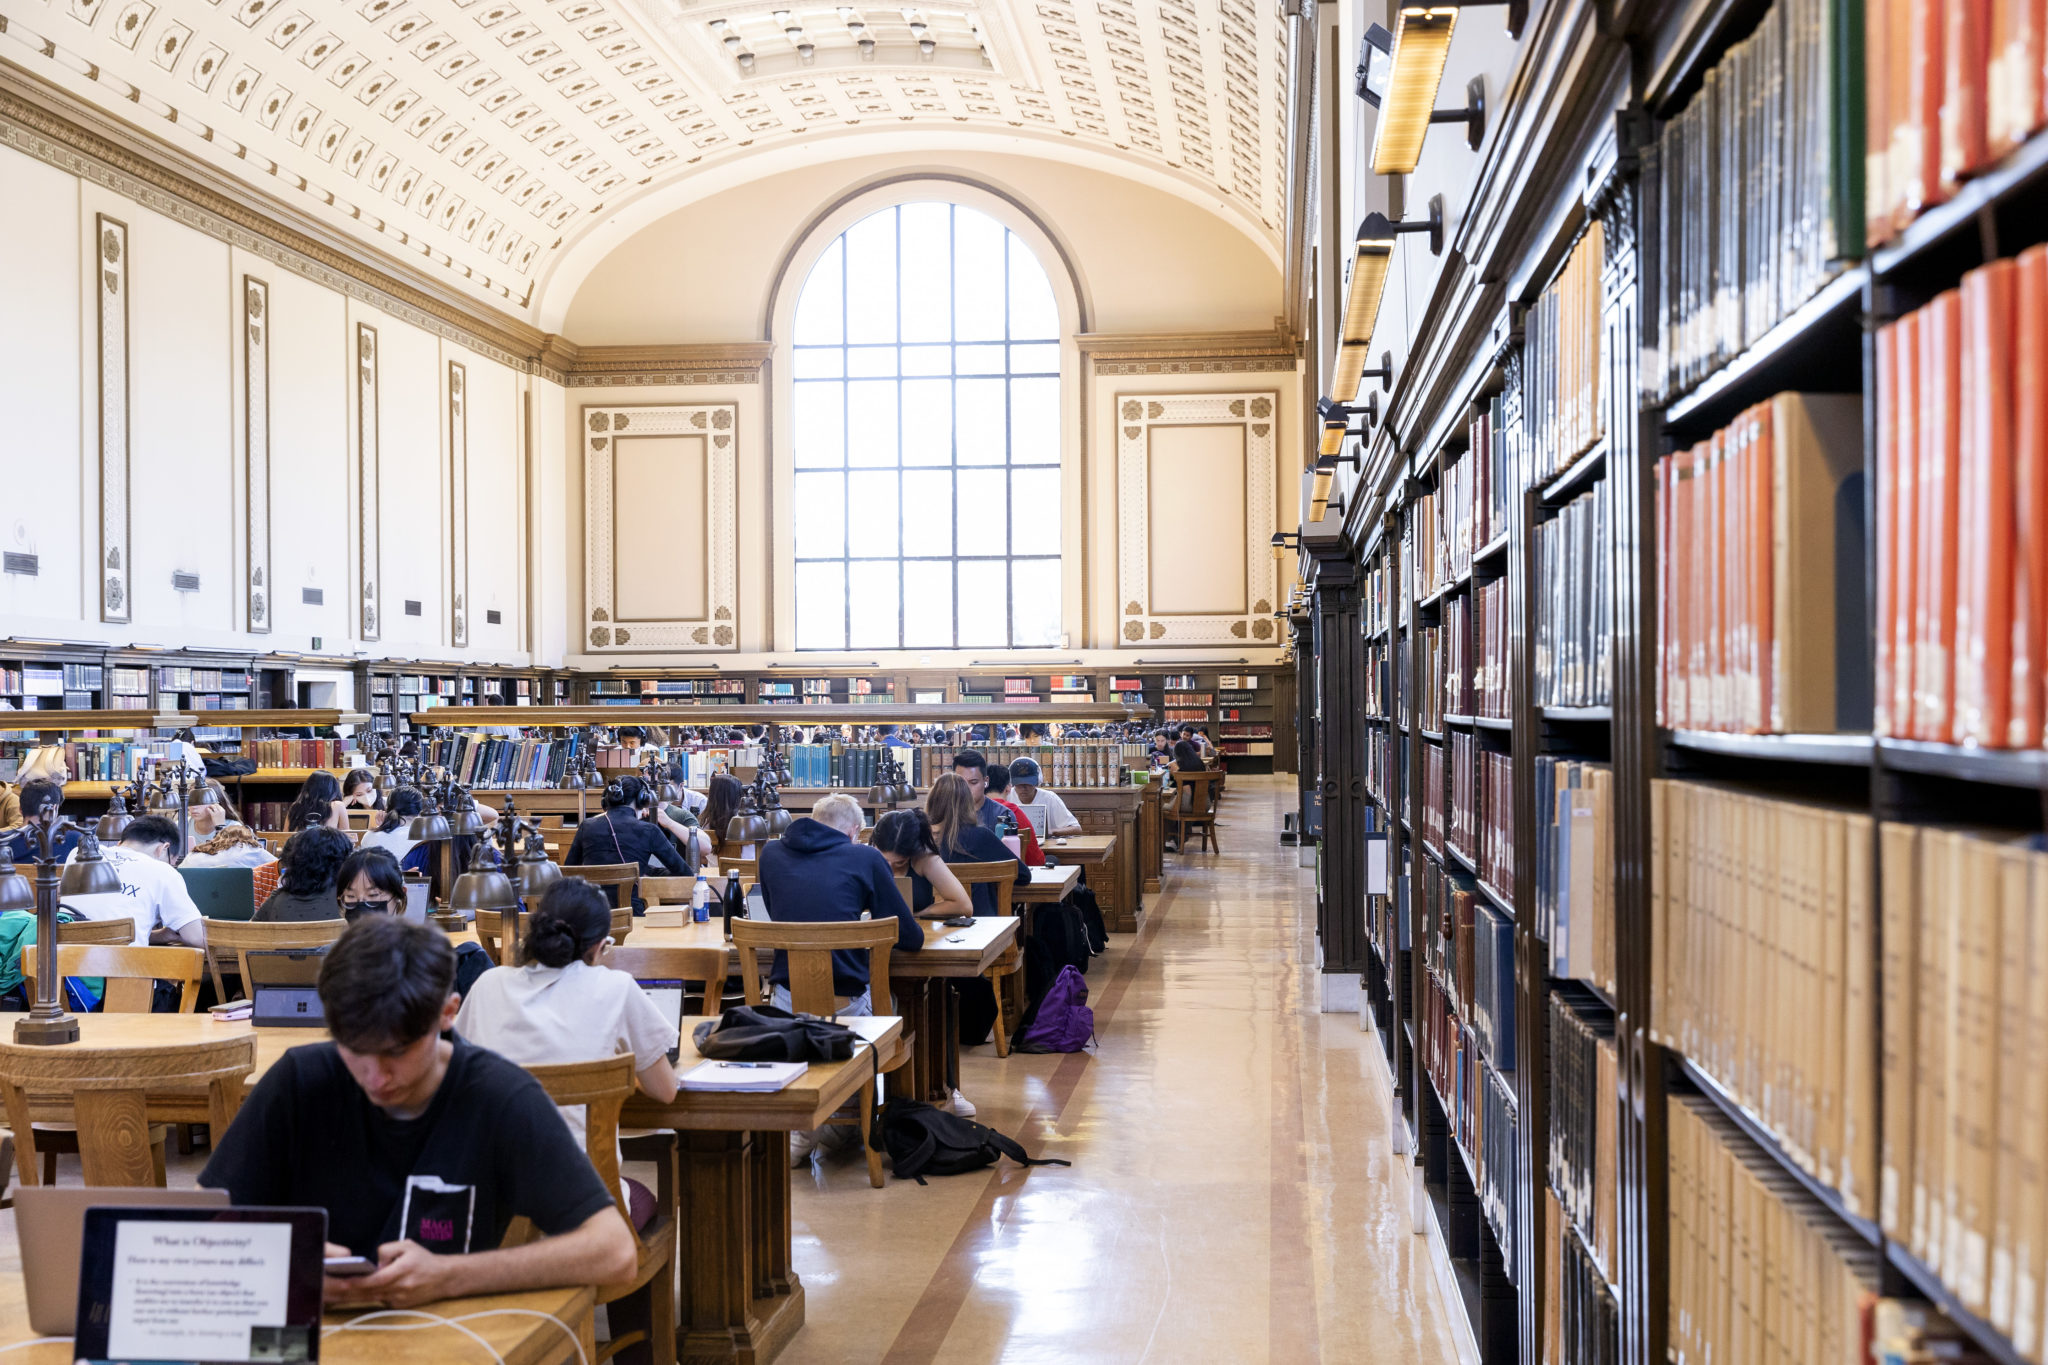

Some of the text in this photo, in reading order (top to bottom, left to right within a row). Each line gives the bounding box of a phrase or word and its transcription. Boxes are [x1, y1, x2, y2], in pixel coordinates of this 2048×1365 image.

[120, 882, 141, 898] YX
[153, 1236, 253, 1249] What is Objectivity?
